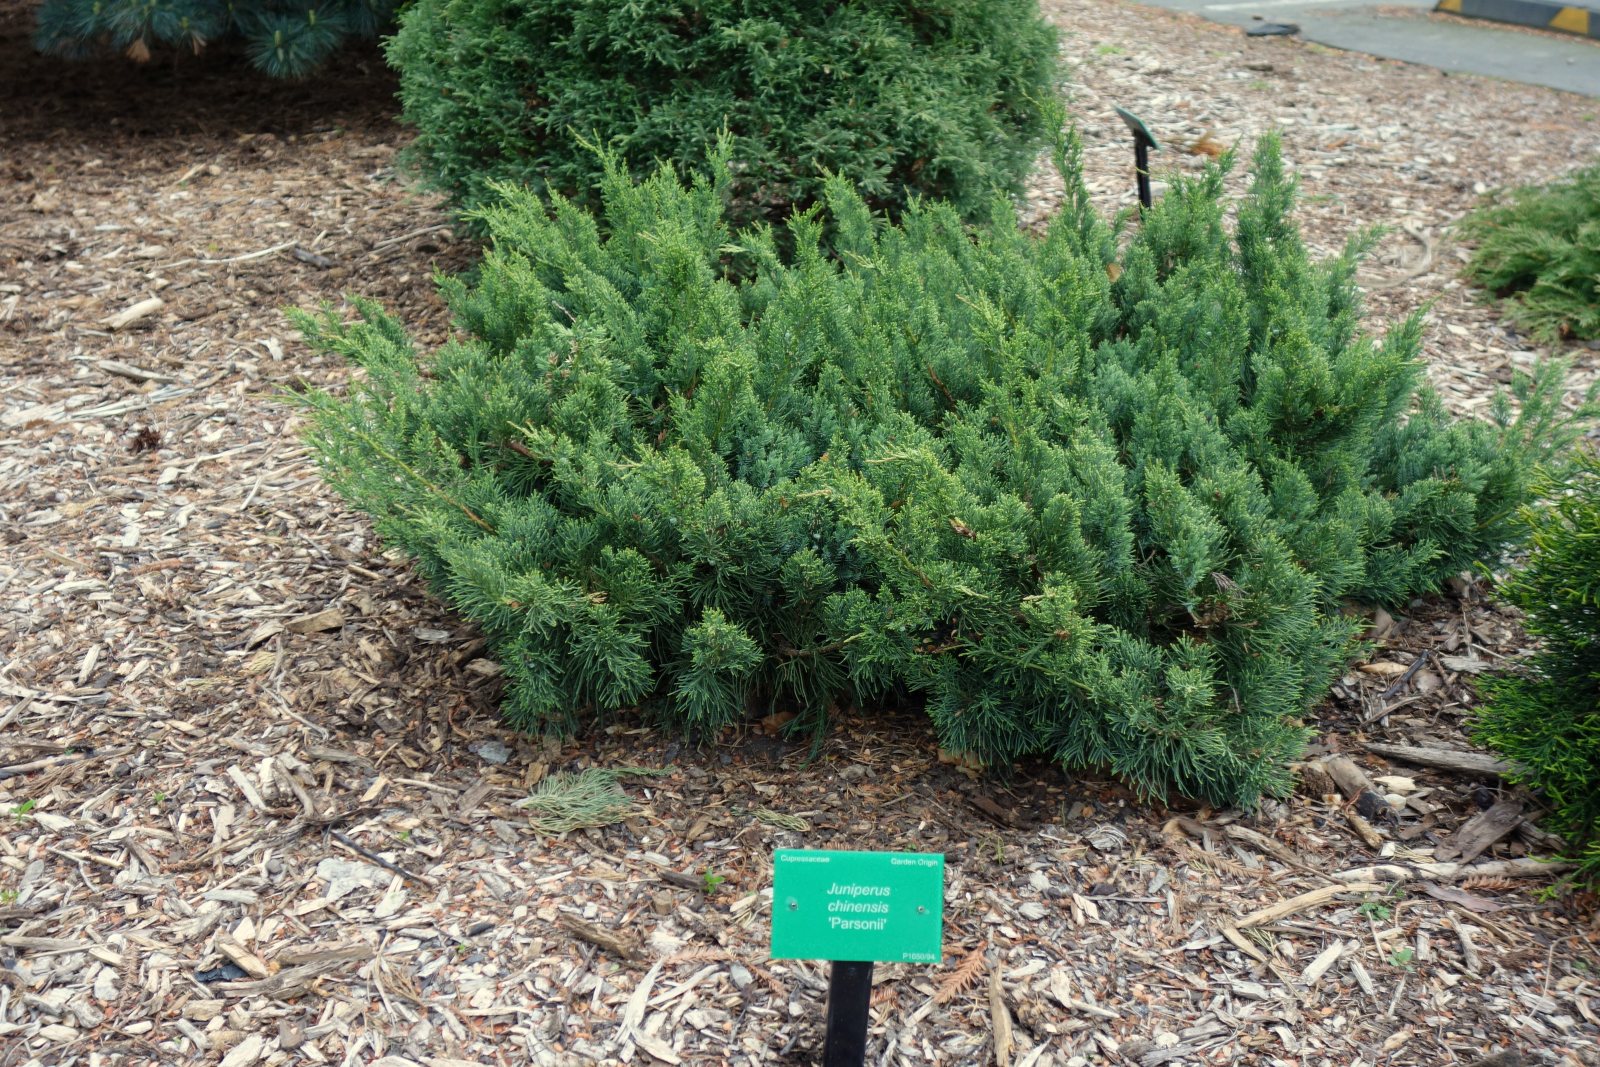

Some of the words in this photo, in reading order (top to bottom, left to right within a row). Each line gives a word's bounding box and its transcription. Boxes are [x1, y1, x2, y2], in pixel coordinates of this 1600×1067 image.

[780, 854, 830, 863] Cupressaceae
[891, 857, 916, 866] Garden
[918, 858, 938, 867] Origin
[827, 882, 891, 898] Juniperus
[828, 901, 889, 914] chinensis
[828, 916, 887, 930] 'Parsonii'
